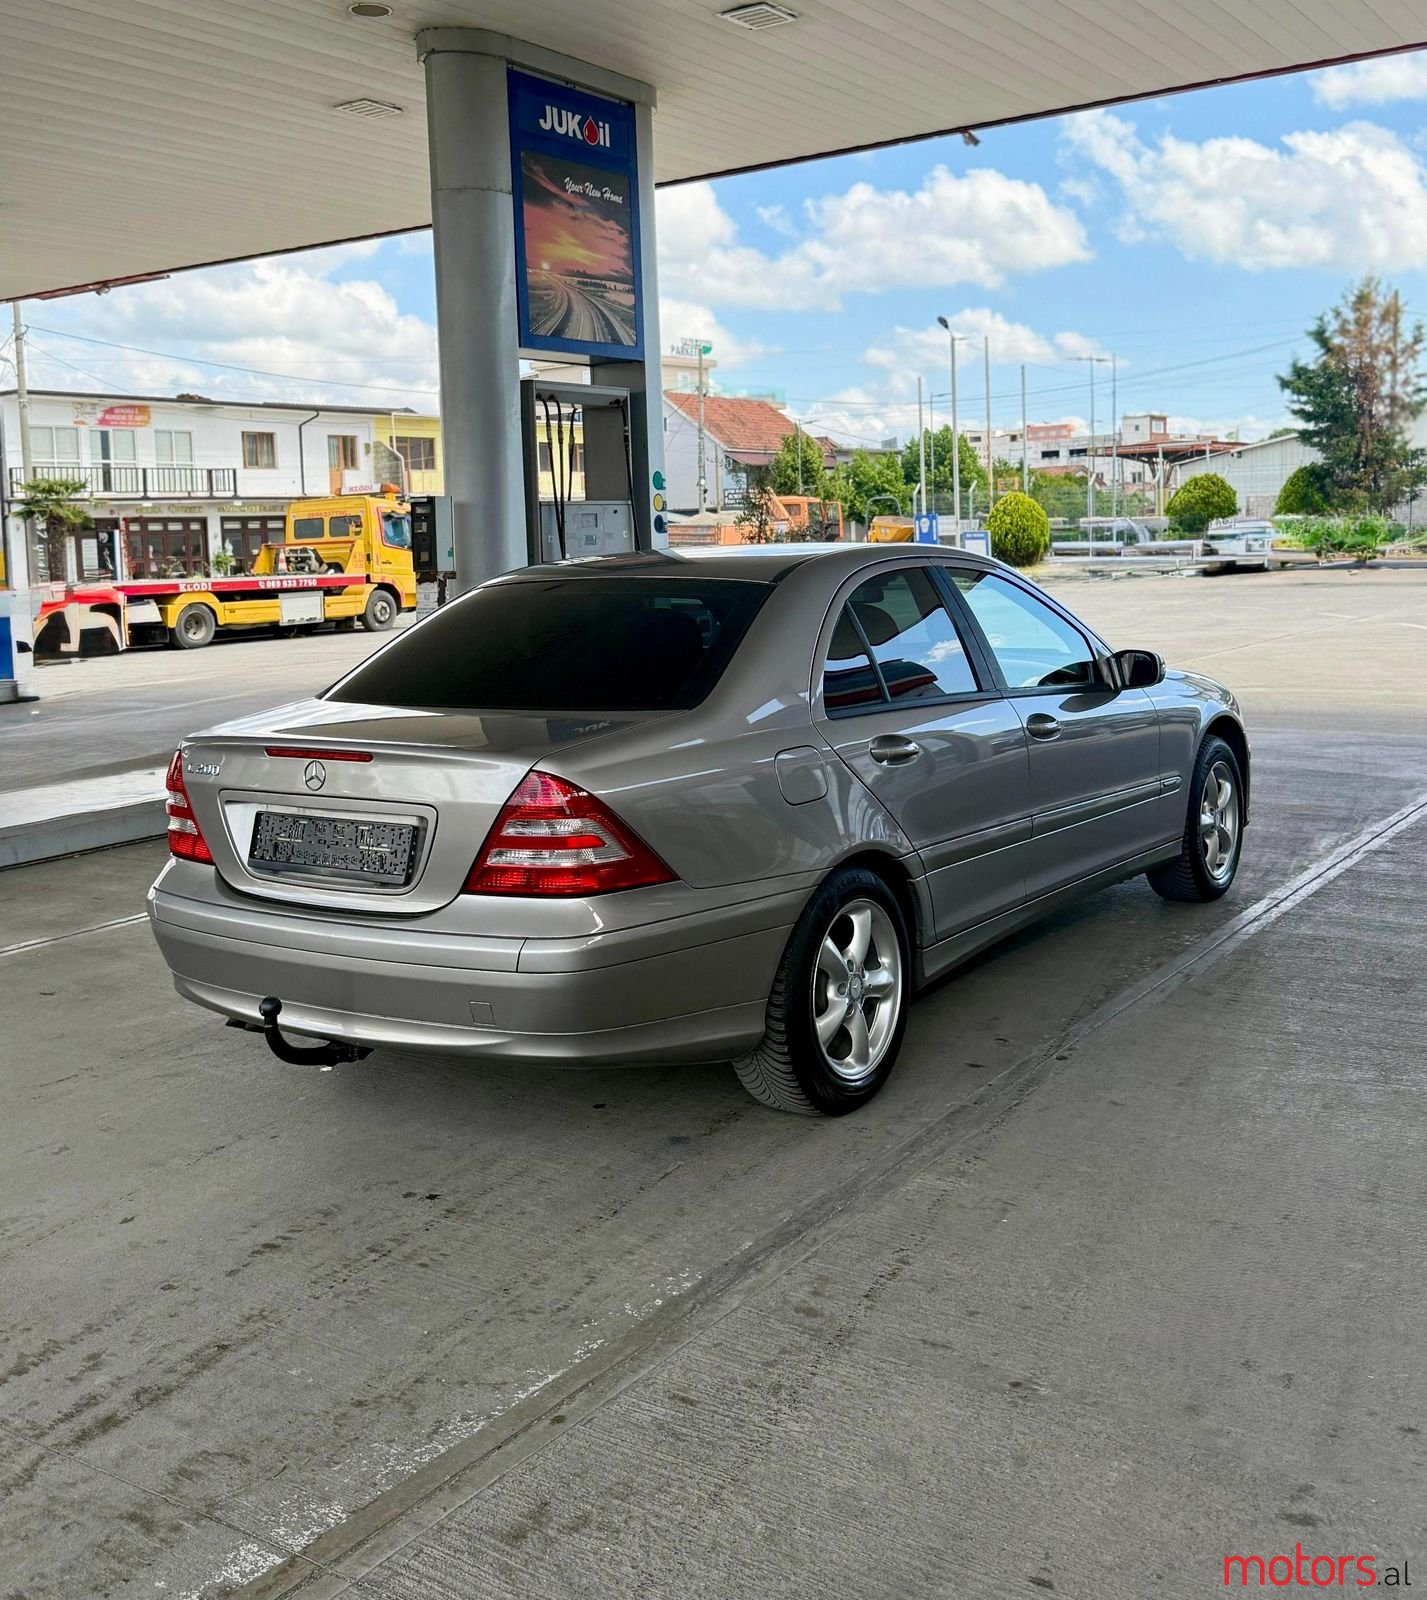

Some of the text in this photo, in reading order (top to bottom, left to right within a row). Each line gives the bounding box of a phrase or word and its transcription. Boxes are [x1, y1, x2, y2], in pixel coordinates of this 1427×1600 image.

[564, 177, 623, 204] Your New Home
[266, 580, 281, 588] 069
